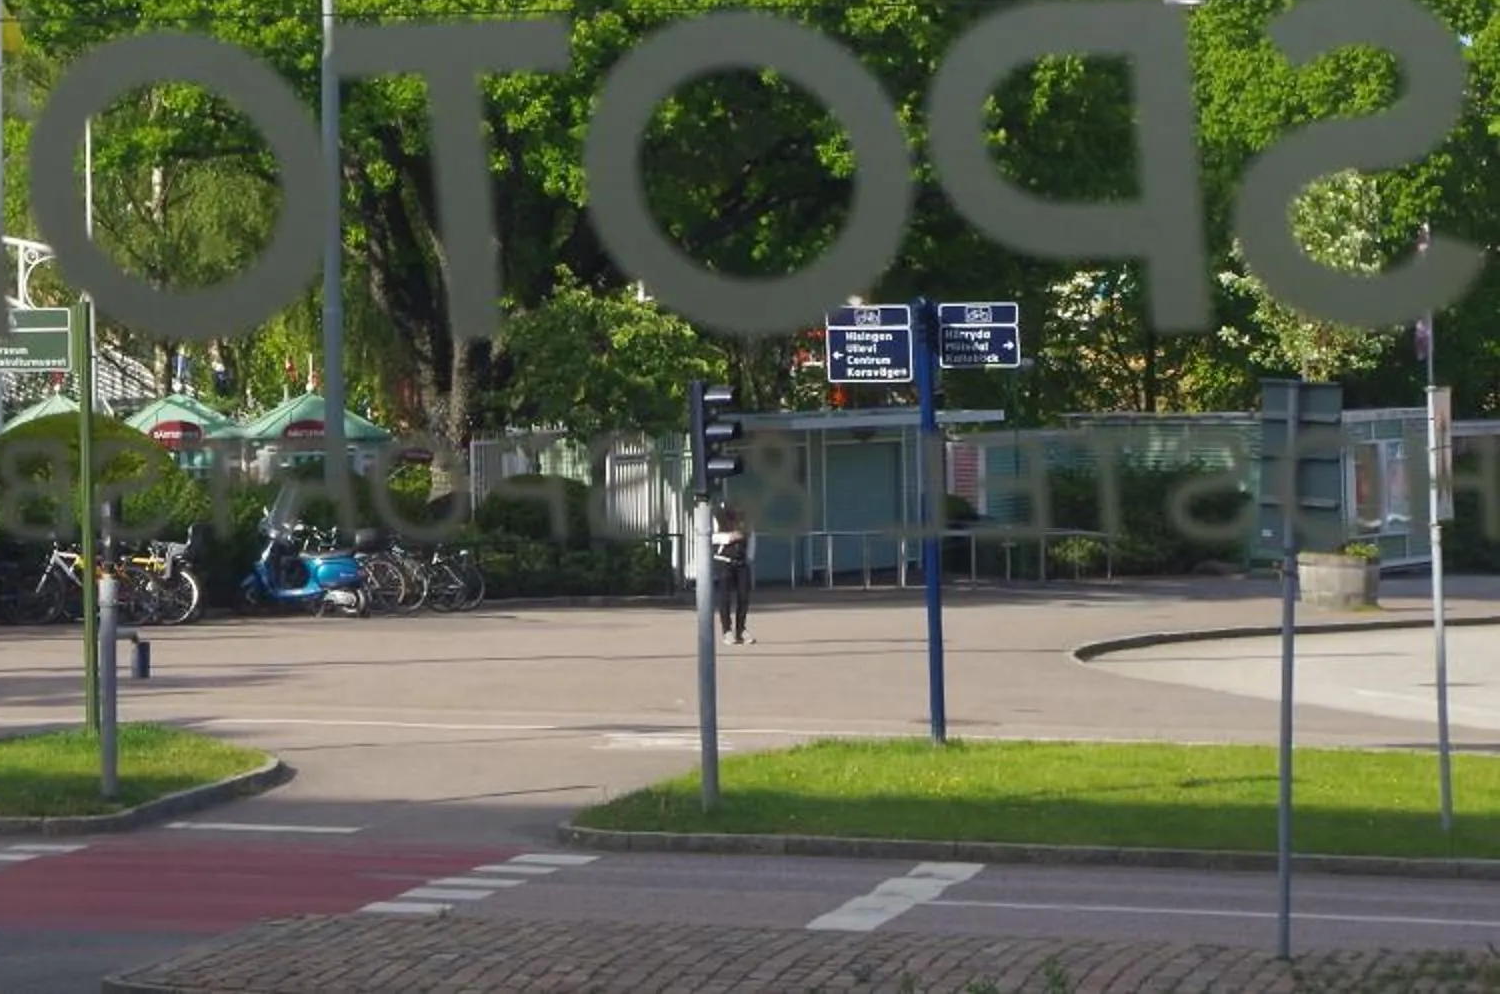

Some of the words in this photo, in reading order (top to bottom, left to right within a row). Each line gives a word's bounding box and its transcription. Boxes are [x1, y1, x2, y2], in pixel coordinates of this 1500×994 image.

[845, 331, 893, 342] Hisingen
[845, 343, 877, 353] Ullevi
[847, 355, 891, 365] Centrum
[847, 367, 908, 379] Korsvägen
